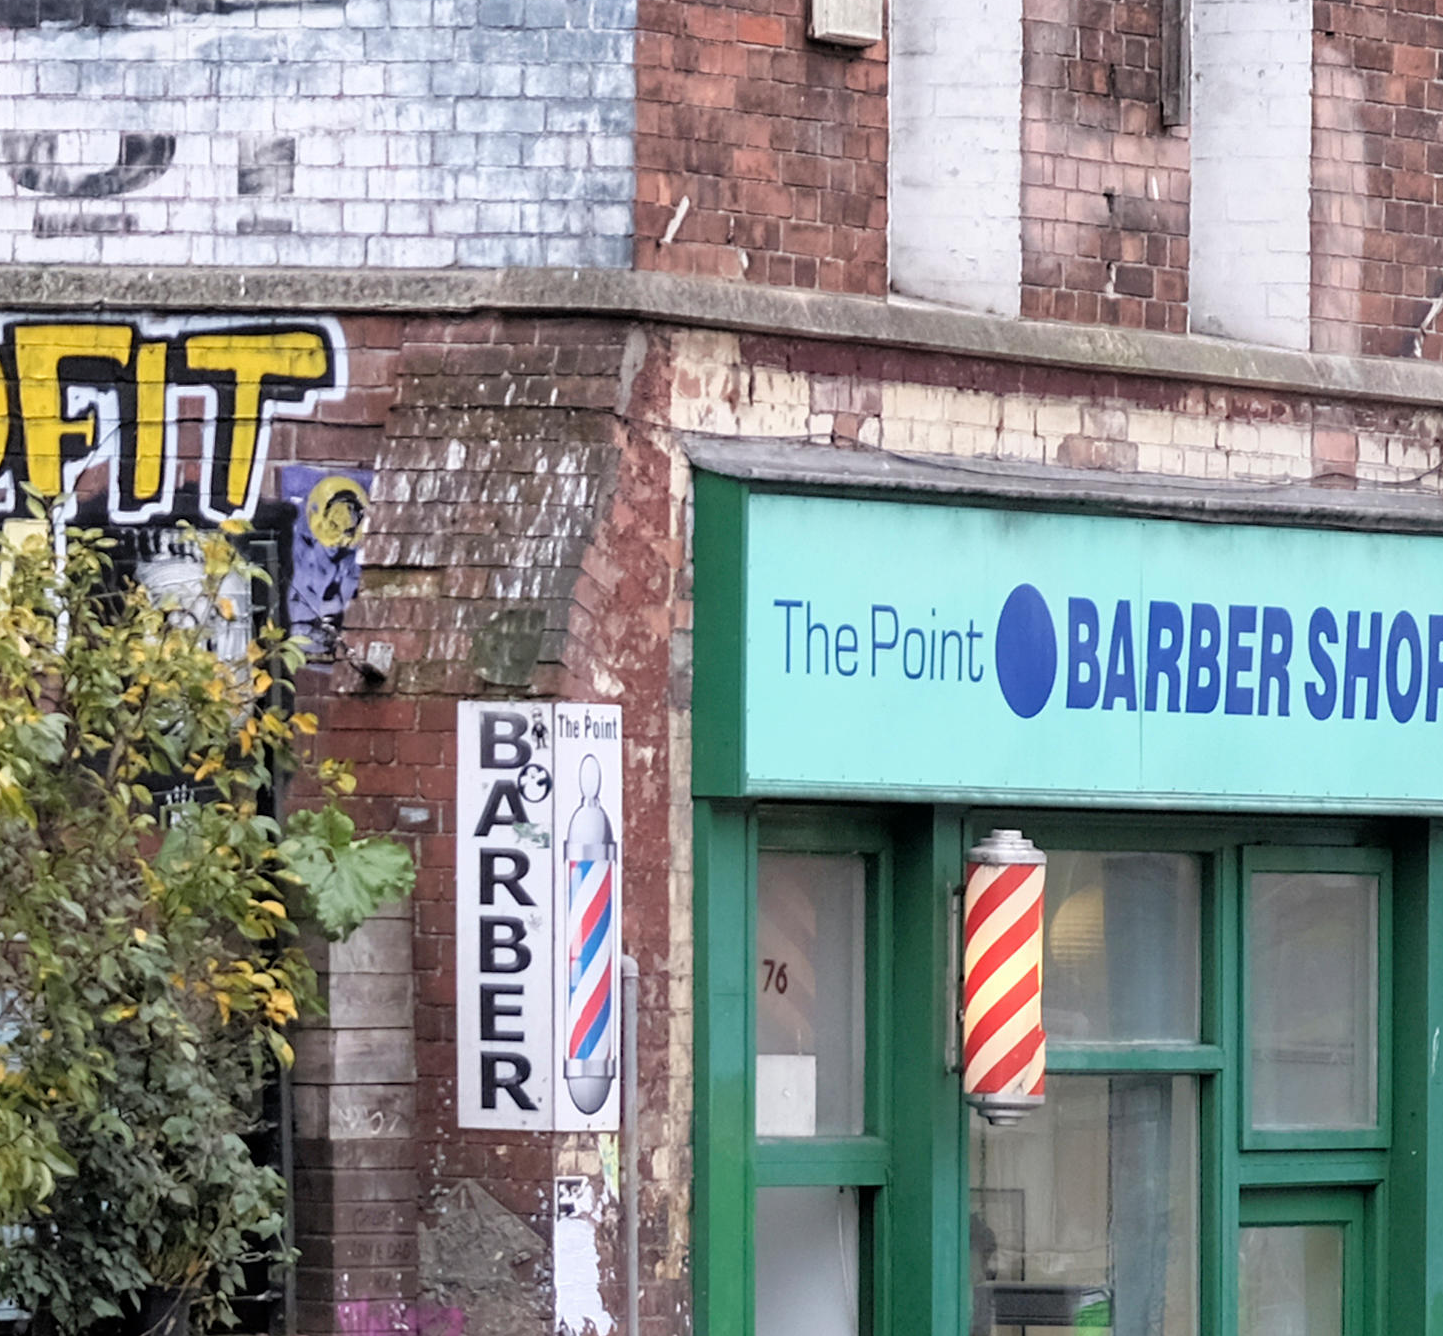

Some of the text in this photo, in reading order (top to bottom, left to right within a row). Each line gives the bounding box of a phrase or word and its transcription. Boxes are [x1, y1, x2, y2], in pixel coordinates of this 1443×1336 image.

[773, 598, 859, 677] The
[870, 604, 984, 684] Point
[1065, 595, 1290, 717] BARBER
[558, 715, 617, 740] The Point
[474, 710, 539, 1111] BARBER
[763, 959, 788, 995] 76
